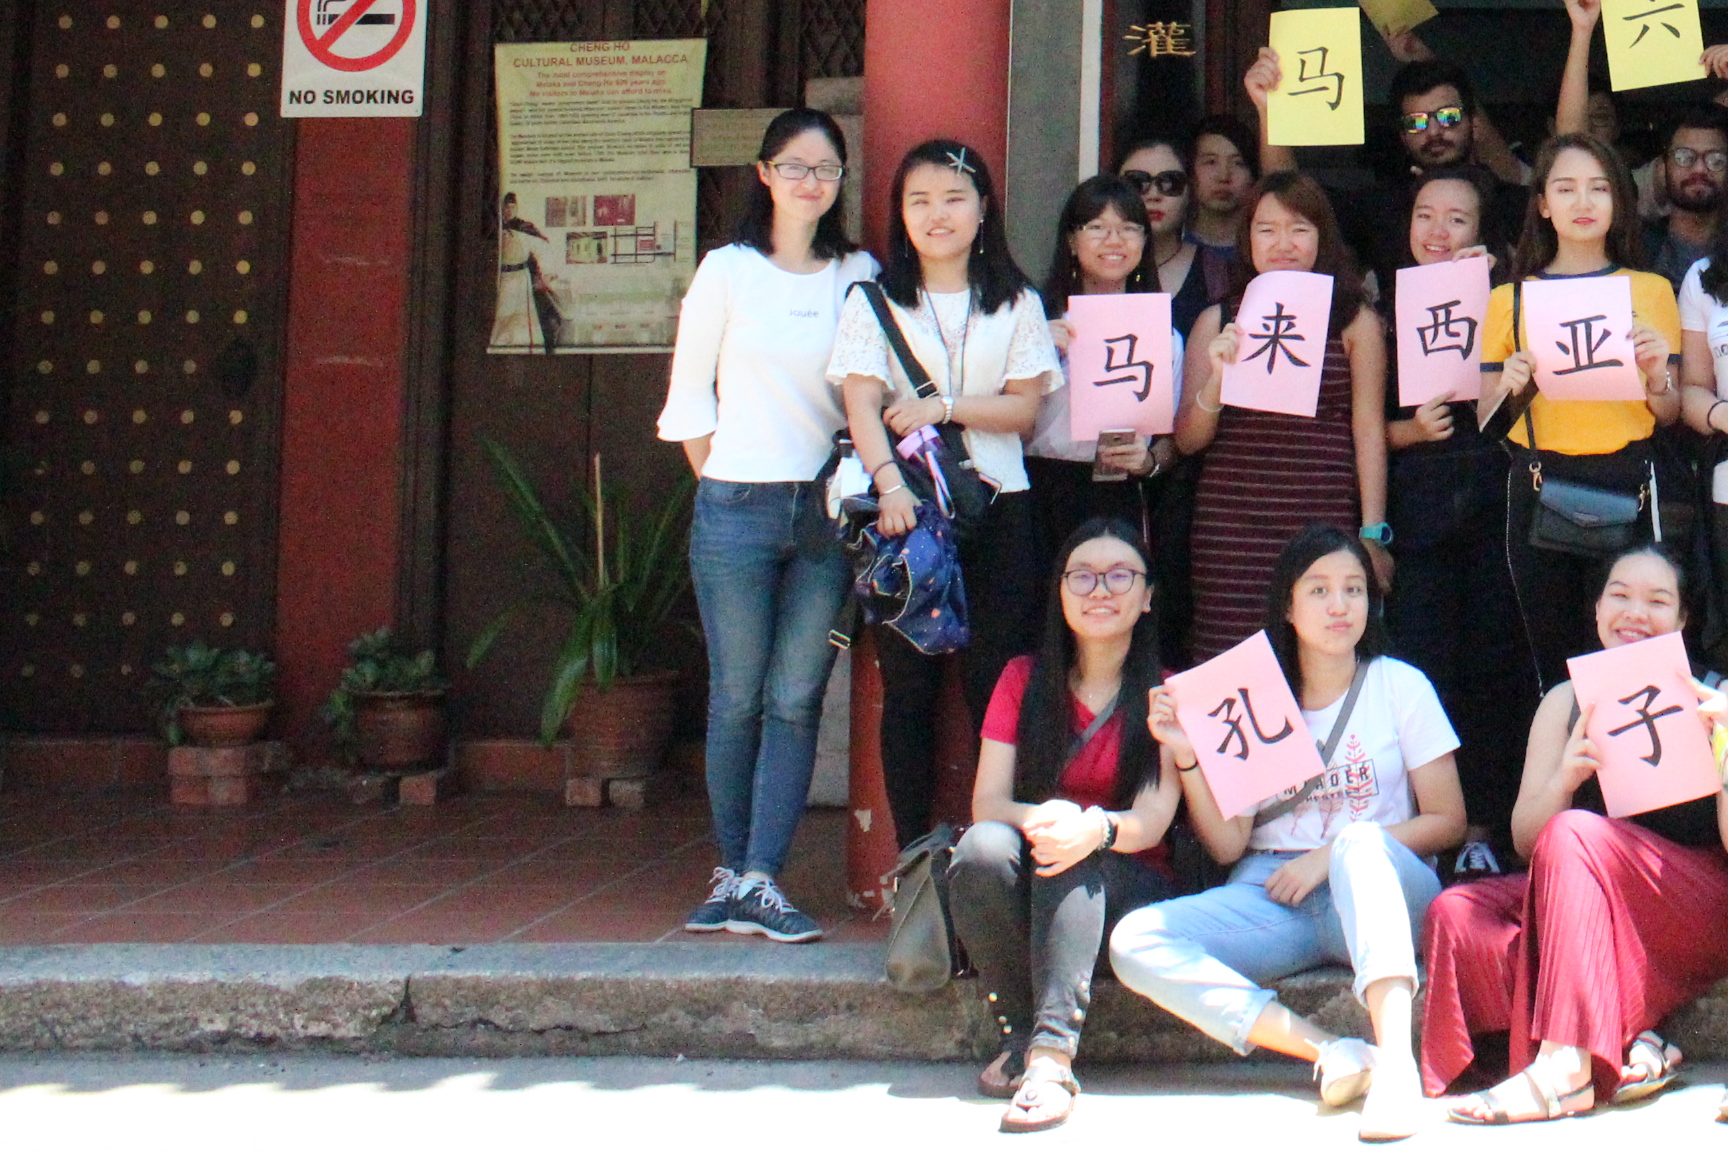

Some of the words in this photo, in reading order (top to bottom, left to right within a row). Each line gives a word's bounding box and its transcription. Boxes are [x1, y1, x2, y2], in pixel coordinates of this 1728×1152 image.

[513, 56, 573, 68] CULTURAL
[631, 53, 690, 65] MALACCA
[570, 42, 610, 53] CHENG
[613, 41, 631, 52] HO
[1287, 45, 1345, 112] 马
[289, 89, 316, 105] NO
[322, 89, 415, 105] SMOKING
[1241, 302, 1311, 376] 来
[1416, 298, 1478, 362] 西
[1551, 314, 1624, 377] 亚
[1091, 333, 1155, 403] 马
[1206, 683, 1295, 762] 孔
[1606, 685, 1687, 767] 子
